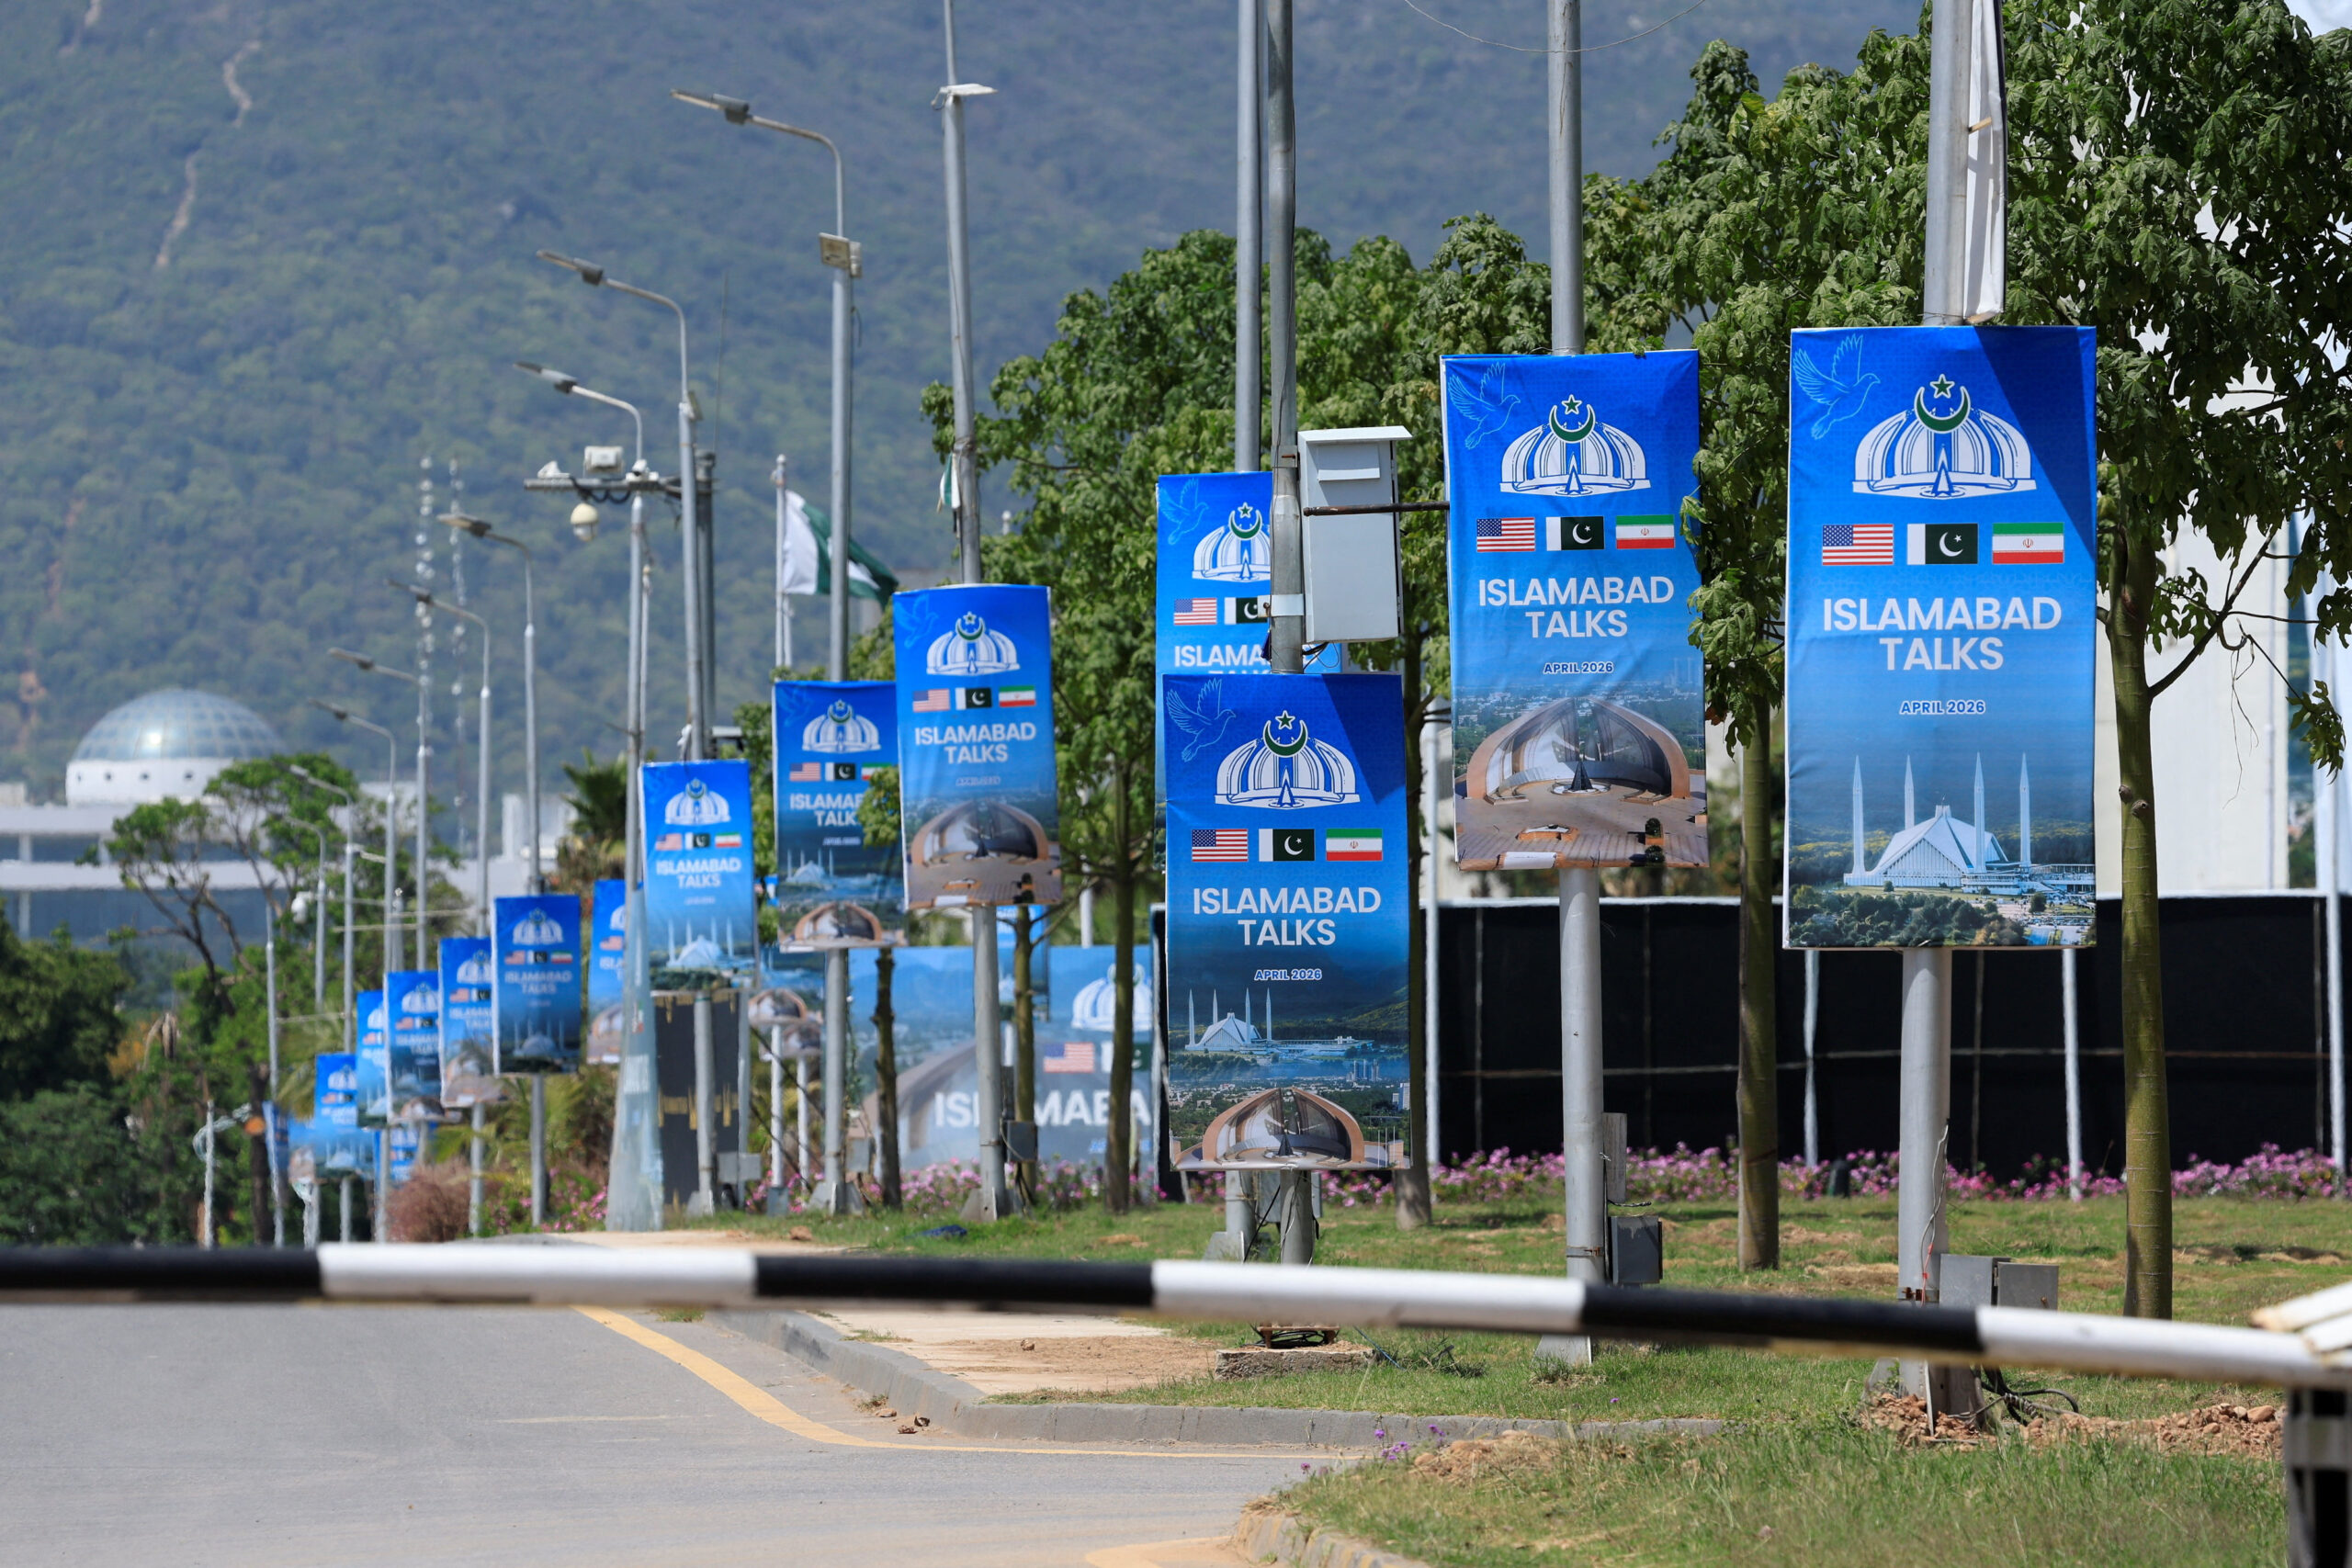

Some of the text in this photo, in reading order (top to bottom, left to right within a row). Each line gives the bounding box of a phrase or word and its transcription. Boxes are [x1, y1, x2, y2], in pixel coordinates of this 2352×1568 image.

[1479, 576, 1674, 606] ISLAMABAD
[1525, 610, 1628, 638] TALKS
[1824, 597, 2062, 631] ISLAMABAD
[1174, 645, 1317, 667] ISLAMA
[1879, 637, 2004, 671] TALKS
[1543, 661, 1614, 674] APRIL 2026
[1899, 700, 1984, 716] APRIL 2026
[914, 722, 1036, 746] ISLAMABAD
[944, 744, 1009, 764] TALKS
[814, 810, 861, 827] TALK
[655, 857, 741, 875] ISLAMABAD
[677, 874, 721, 889] TALKS
[1193, 887, 1382, 915] ISLAMABAD
[1238, 919, 1336, 946] TALKS
[1254, 968, 1323, 981] APRIL 2026
